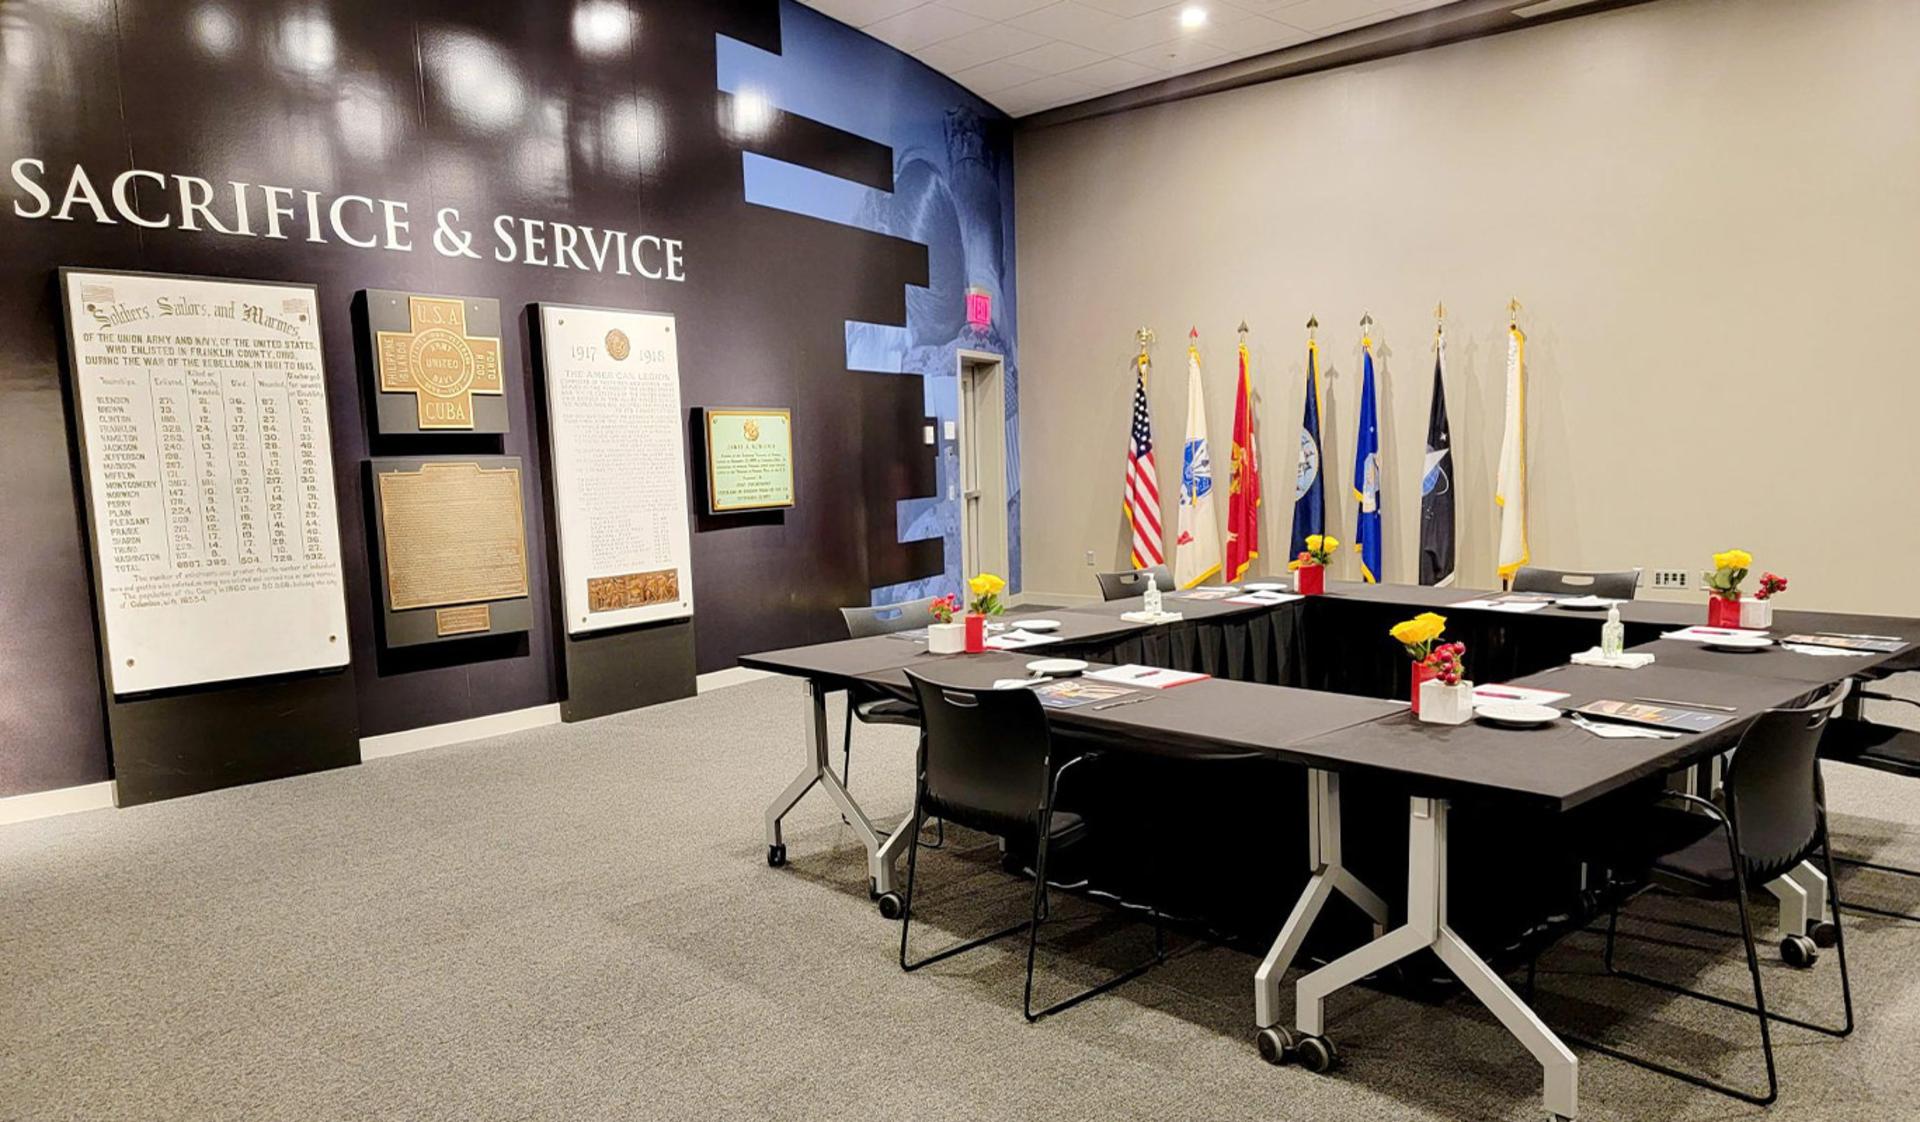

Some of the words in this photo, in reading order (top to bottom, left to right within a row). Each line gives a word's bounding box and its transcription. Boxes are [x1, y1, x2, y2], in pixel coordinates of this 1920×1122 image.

[10, 157, 413, 253] SACRIFICE
[432, 208, 482, 259] &
[493, 215, 686, 282] SERVICE
[214, 301, 235, 319] and
[83, 333, 94, 341] OF
[96, 333, 114, 342] THE
[118, 335, 142, 343] UNION
[146, 336, 171, 344] ARMY
[175, 336, 192, 345] AND
[234, 339, 250, 347] THE
[253, 340, 282, 348] UNITED
[105, 345, 127, 354] WHO
[131, 346, 174, 355] ENLISTED
[178, 347, 186, 355] IN
[191, 348, 234, 357] FRANKLIN
[571, 344, 596, 362] 1917
[640, 349, 665, 364] 1918
[85, 356, 119, 365] DURING
[122, 357, 140, 366] THE
[143, 357, 165, 366] WAR
[168, 358, 178, 366] OF
[183, 358, 199, 367] THE
[384, 338, 396, 385] PHILIPPINE
[397, 342, 409, 383] ISLANDS
[565, 370, 585, 378] THE
[426, 402, 465, 420] CUBA
[104, 453, 145, 461] JEFFERSON
[106, 481, 156, 489] MONTGOMERY
[109, 509, 131, 517] PLAIN
[109, 518, 149, 526] PLEASANT
[114, 553, 160, 563] WASHINGTON
